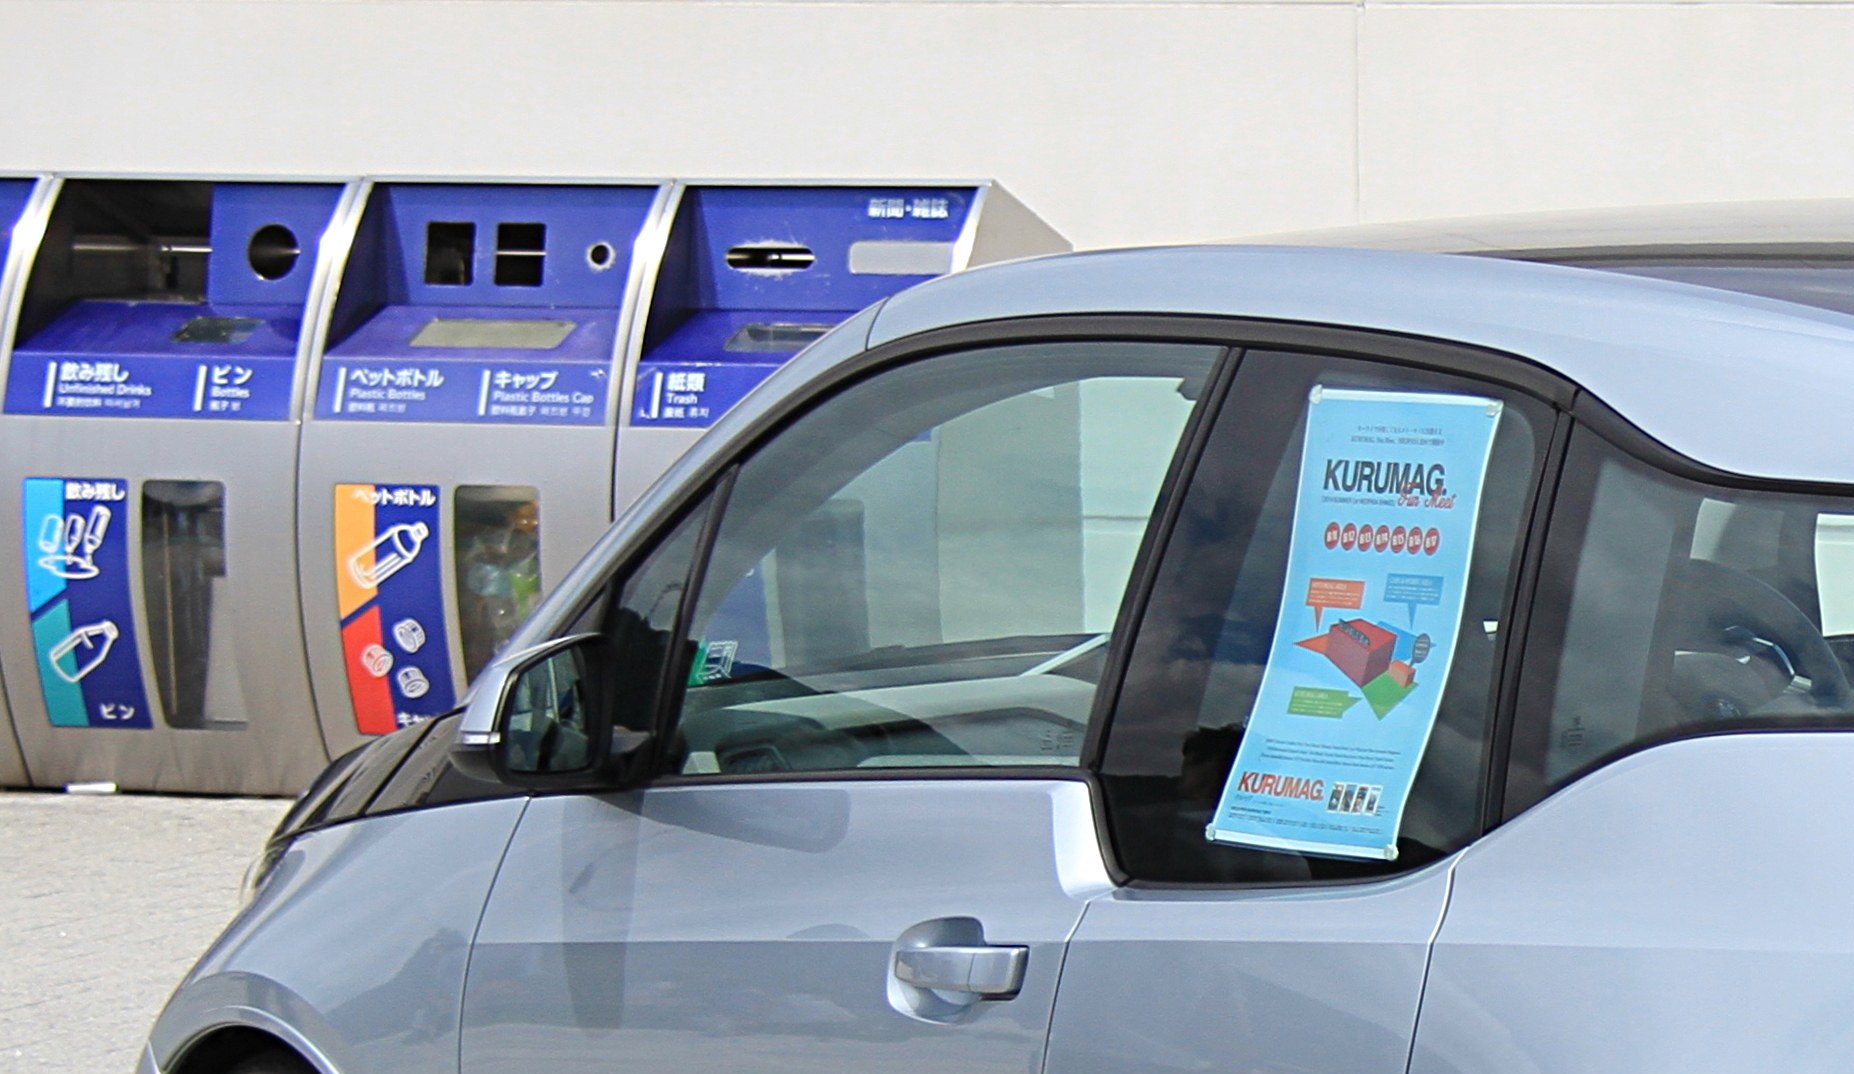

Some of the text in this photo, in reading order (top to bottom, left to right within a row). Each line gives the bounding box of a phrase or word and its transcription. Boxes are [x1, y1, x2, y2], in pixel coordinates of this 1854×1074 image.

[60, 362, 130, 382] 飲み残し
[351, 368, 445, 388] ペットボトル
[494, 370, 559, 390] キャップ
[58, 383, 151, 397] Unfinished Drinks
[211, 386, 250, 399] Bottles
[350, 388, 426, 401] Plastic Bottles
[493, 391, 594, 406] Plastic Bottles Cap
[666, 392, 698, 404] Trash
[1322, 458, 1448, 496] KURUMAG.
[65, 482, 125, 501] 飲み残し
[353, 487, 436, 506] ペットボトル
